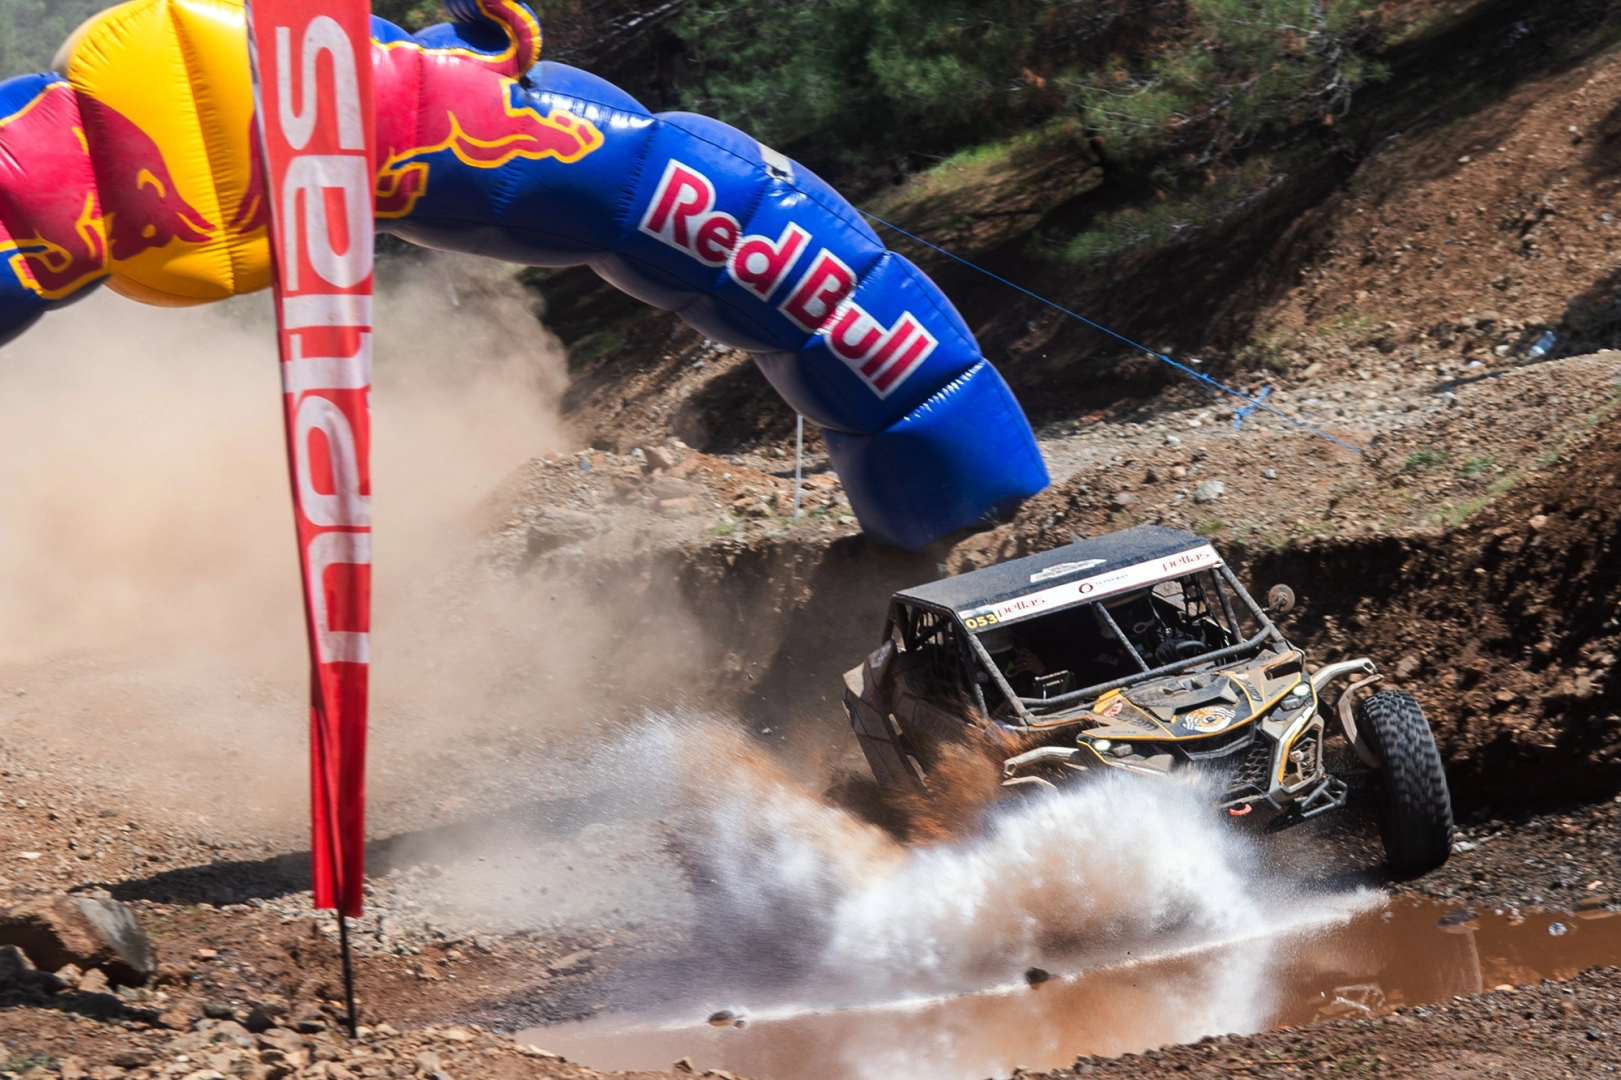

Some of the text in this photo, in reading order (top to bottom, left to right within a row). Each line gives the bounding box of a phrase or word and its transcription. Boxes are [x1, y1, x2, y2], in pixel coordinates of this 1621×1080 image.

[637, 157, 939, 400] Red Bull
[1162, 551, 1210, 572] petlas
[997, 597, 1046, 618] petlas
[965, 613, 999, 630] 053
